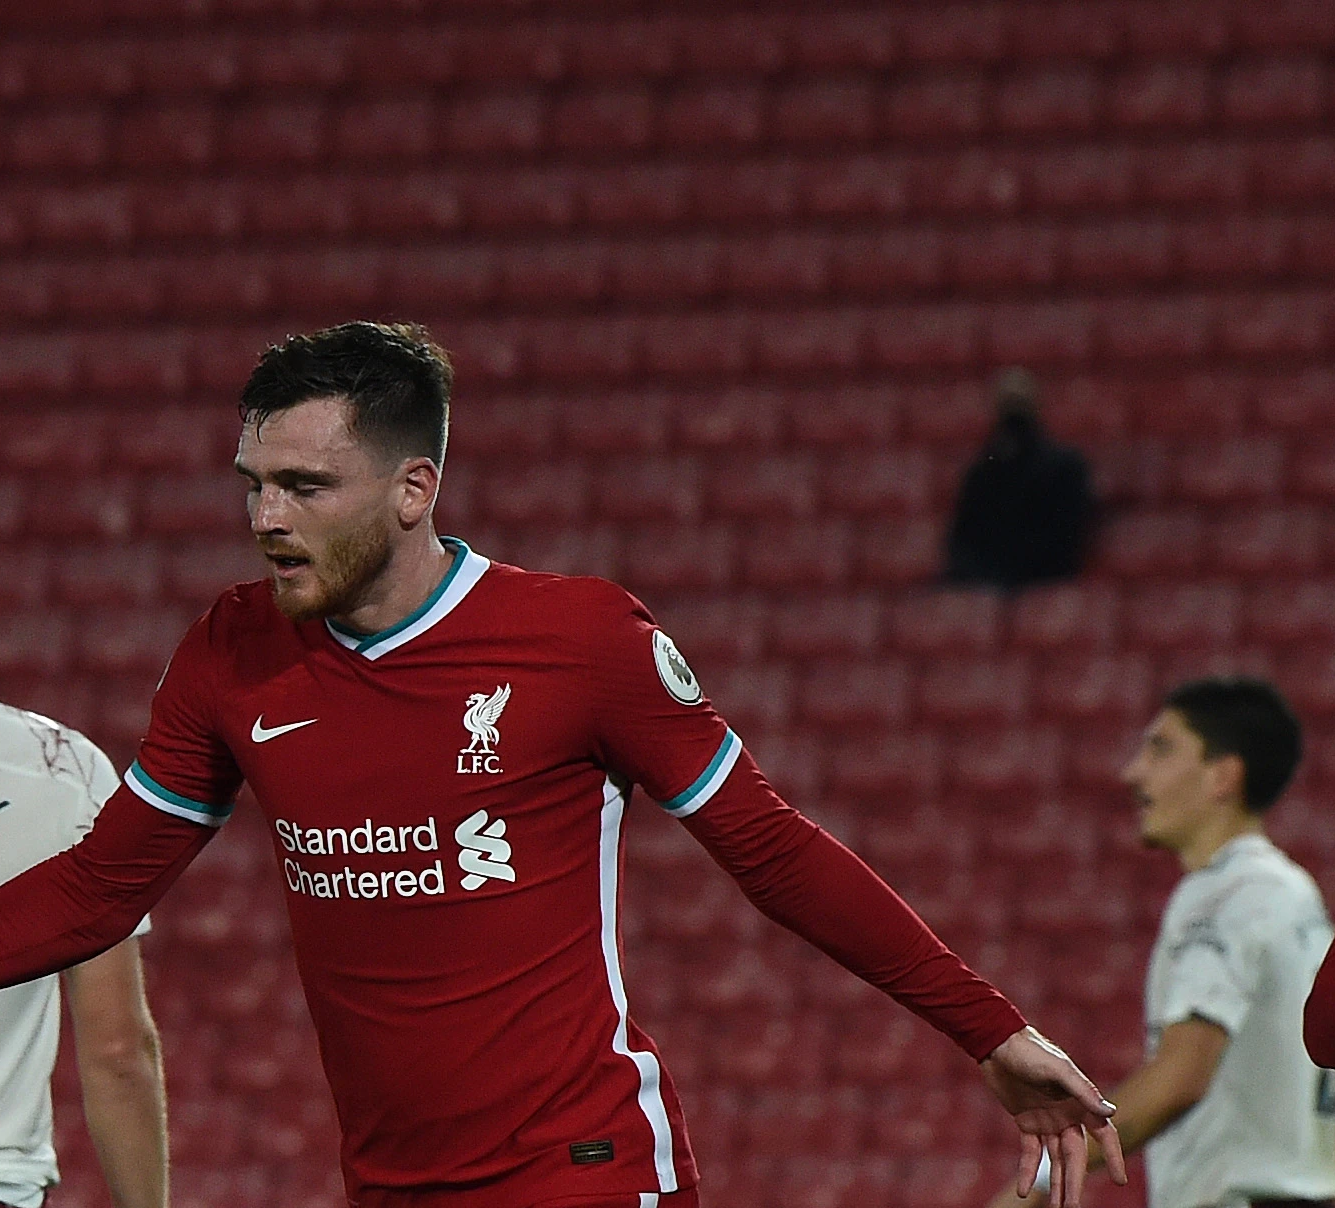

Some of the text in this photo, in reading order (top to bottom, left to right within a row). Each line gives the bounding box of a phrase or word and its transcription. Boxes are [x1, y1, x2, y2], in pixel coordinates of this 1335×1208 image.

[456, 755, 504, 774] L.F.C.
[275, 816, 439, 855] Standard
[283, 857, 446, 899] Chartered
